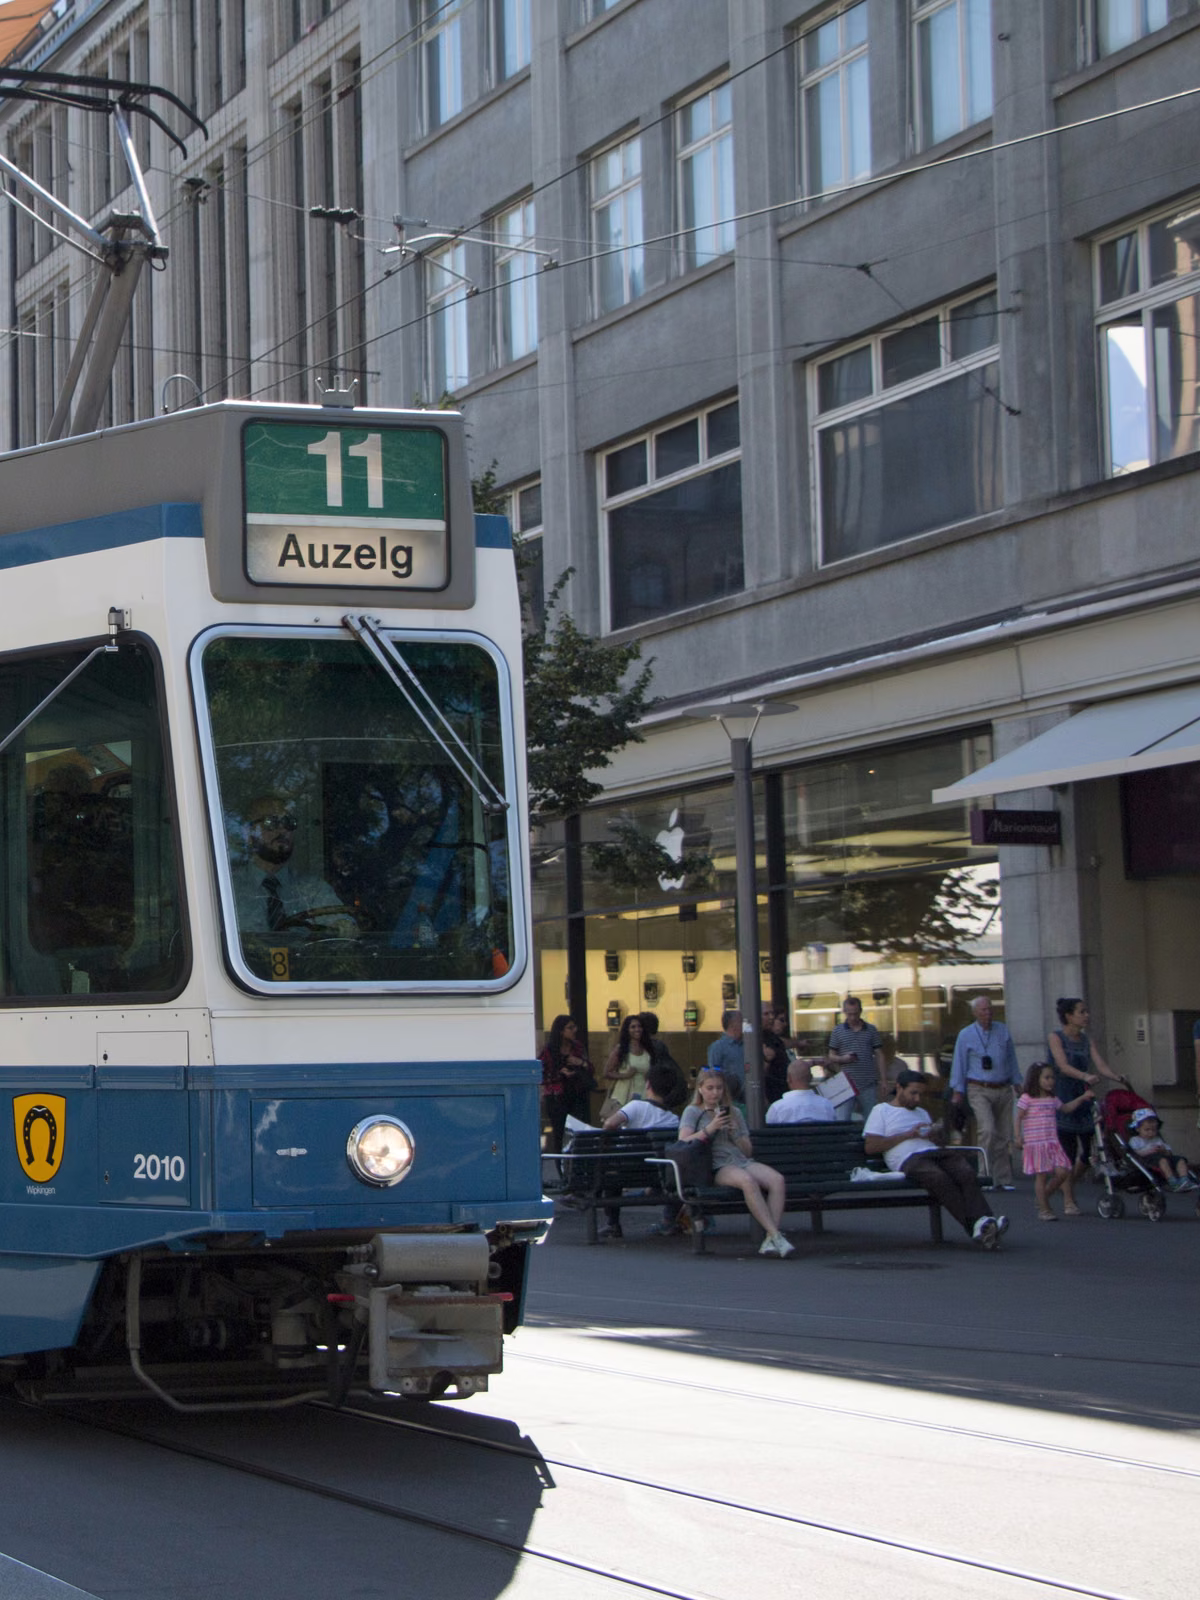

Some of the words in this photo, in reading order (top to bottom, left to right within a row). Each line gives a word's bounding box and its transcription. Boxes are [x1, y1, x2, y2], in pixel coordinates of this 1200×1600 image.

[307, 431, 384, 509] 11
[277, 533, 414, 579] Auzelg
[272, 951, 287, 977] 8
[133, 1153, 186, 1182] 2010
[26, 1185, 56, 1196] Wipkingen
